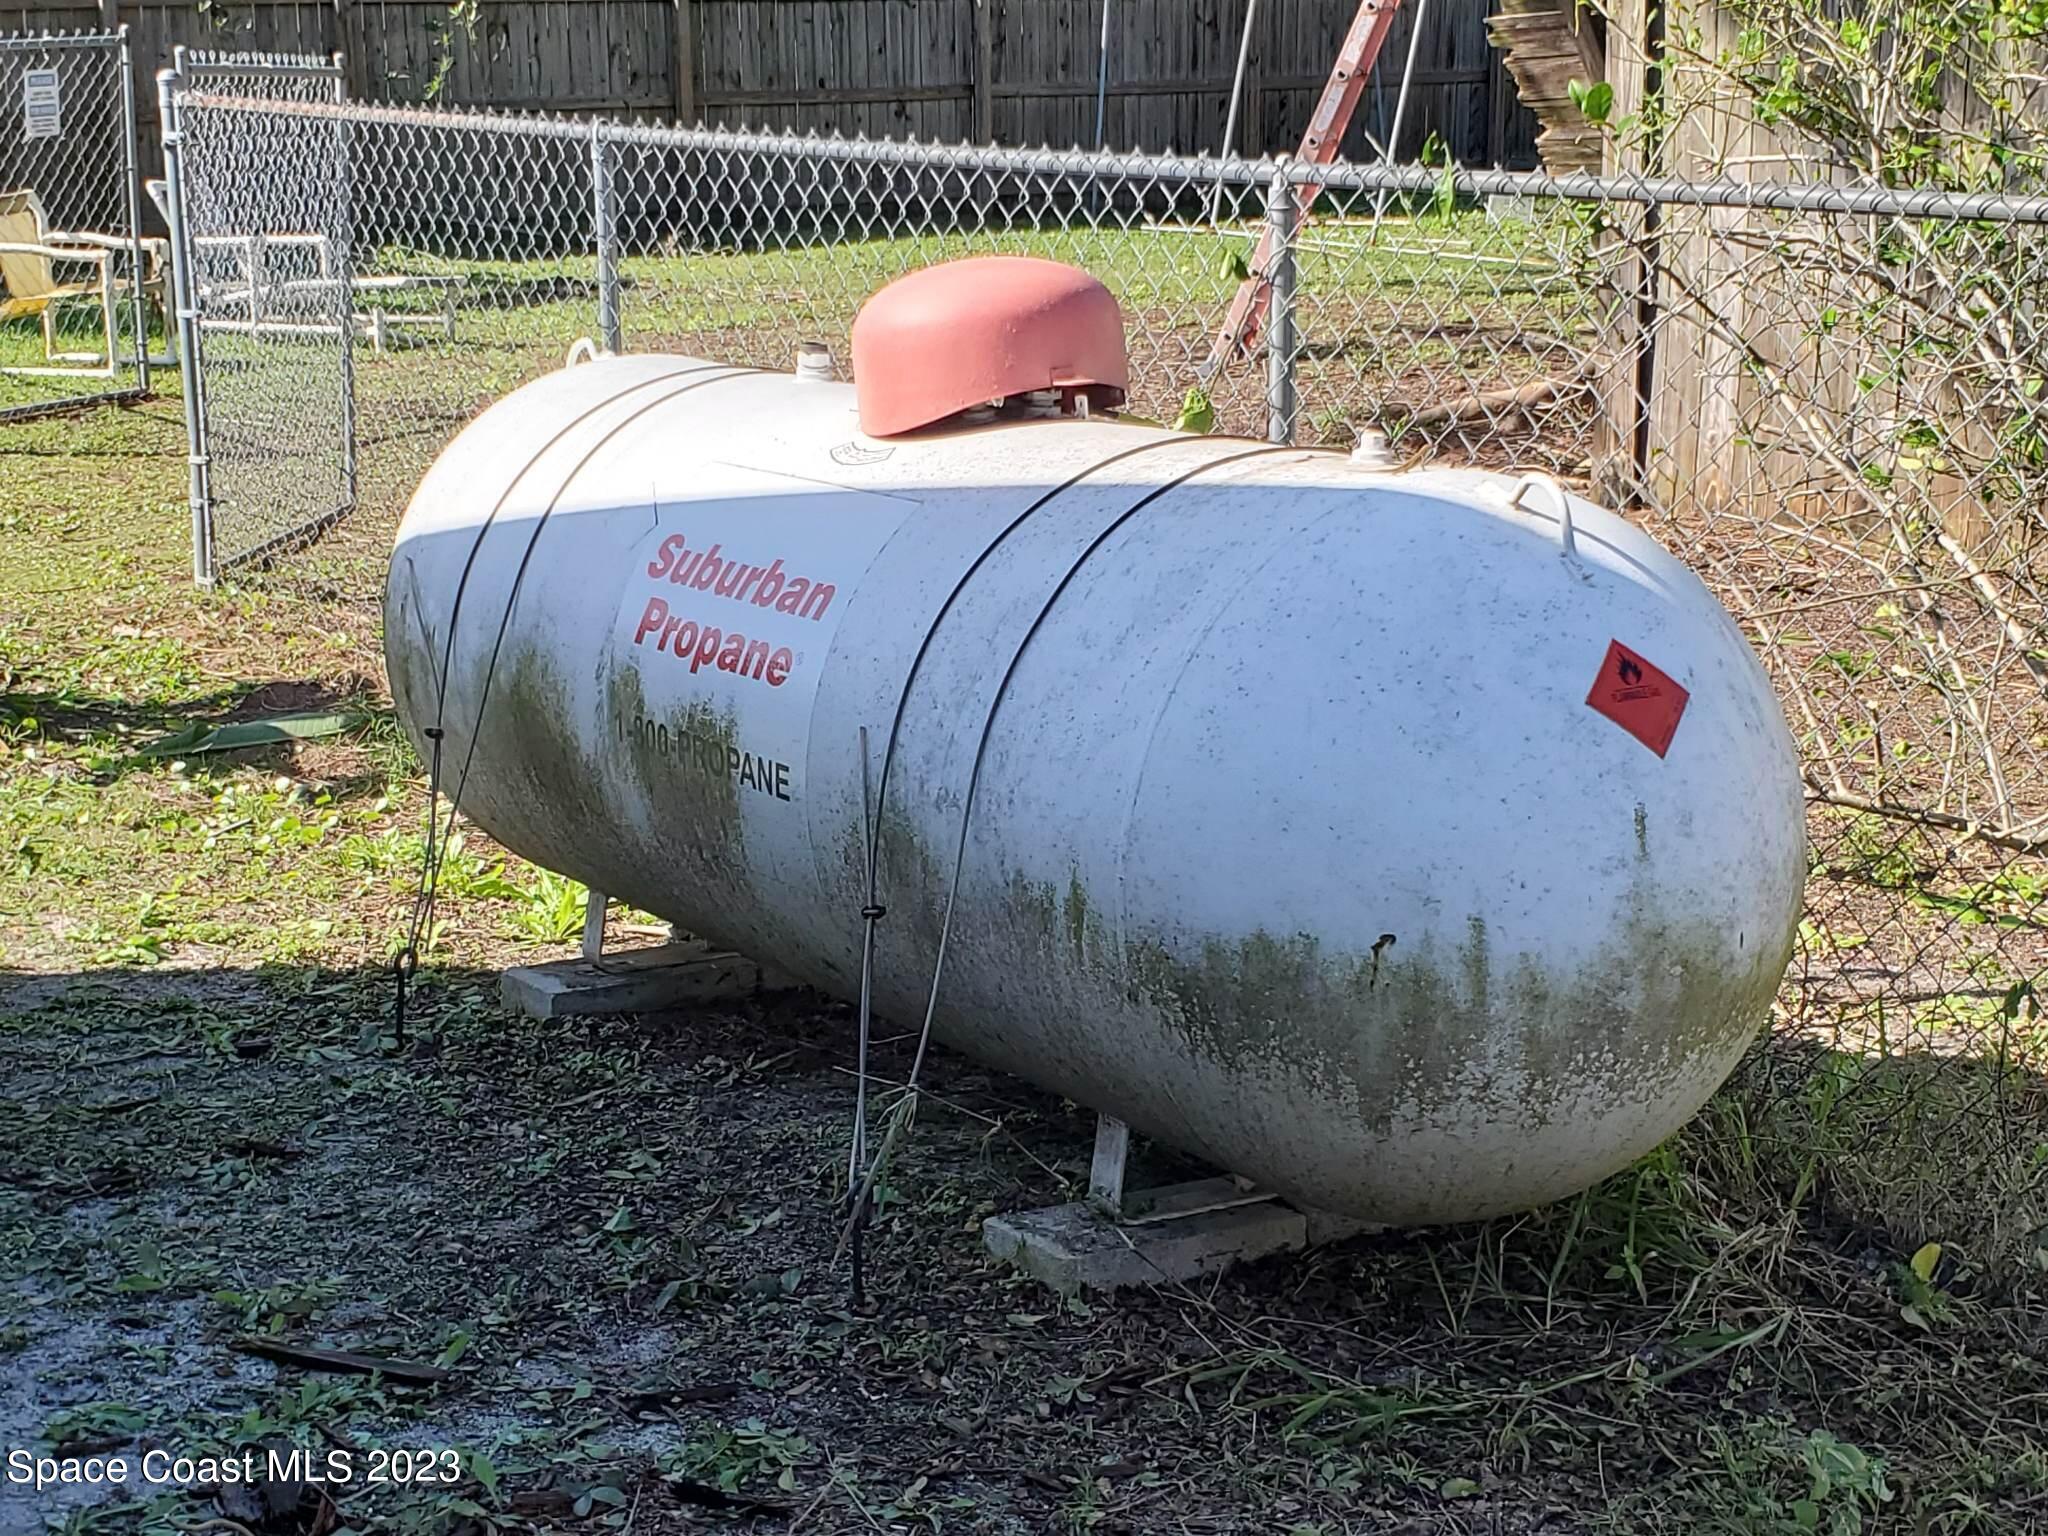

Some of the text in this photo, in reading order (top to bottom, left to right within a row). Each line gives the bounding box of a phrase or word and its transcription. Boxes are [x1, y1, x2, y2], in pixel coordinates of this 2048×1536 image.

[648, 533, 836, 621] Suburban
[634, 597, 793, 686] Propane
[615, 711, 790, 801] 1-800-PROPANE
